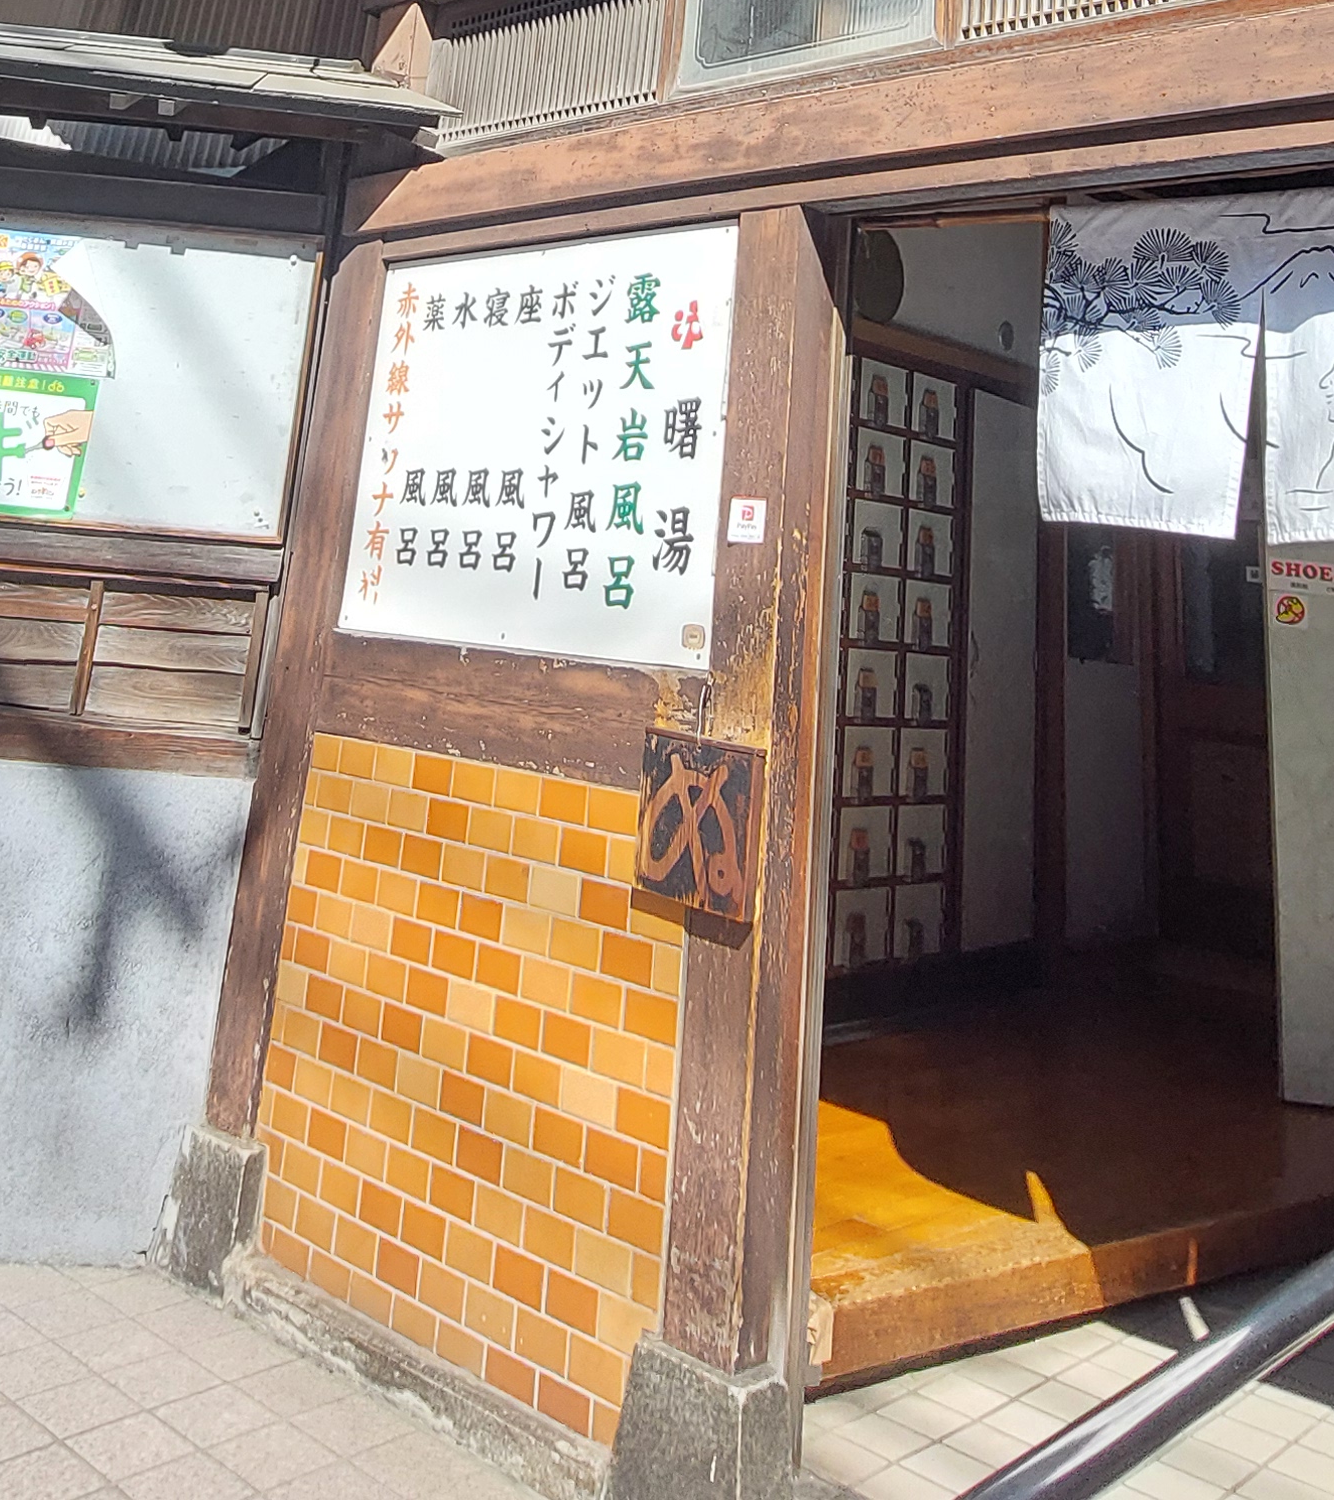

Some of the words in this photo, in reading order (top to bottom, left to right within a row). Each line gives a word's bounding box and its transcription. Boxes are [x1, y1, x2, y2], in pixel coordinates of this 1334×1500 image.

[603, 272, 662, 609] 露天岩風呂
[653, 397, 703, 576] 曙湯
